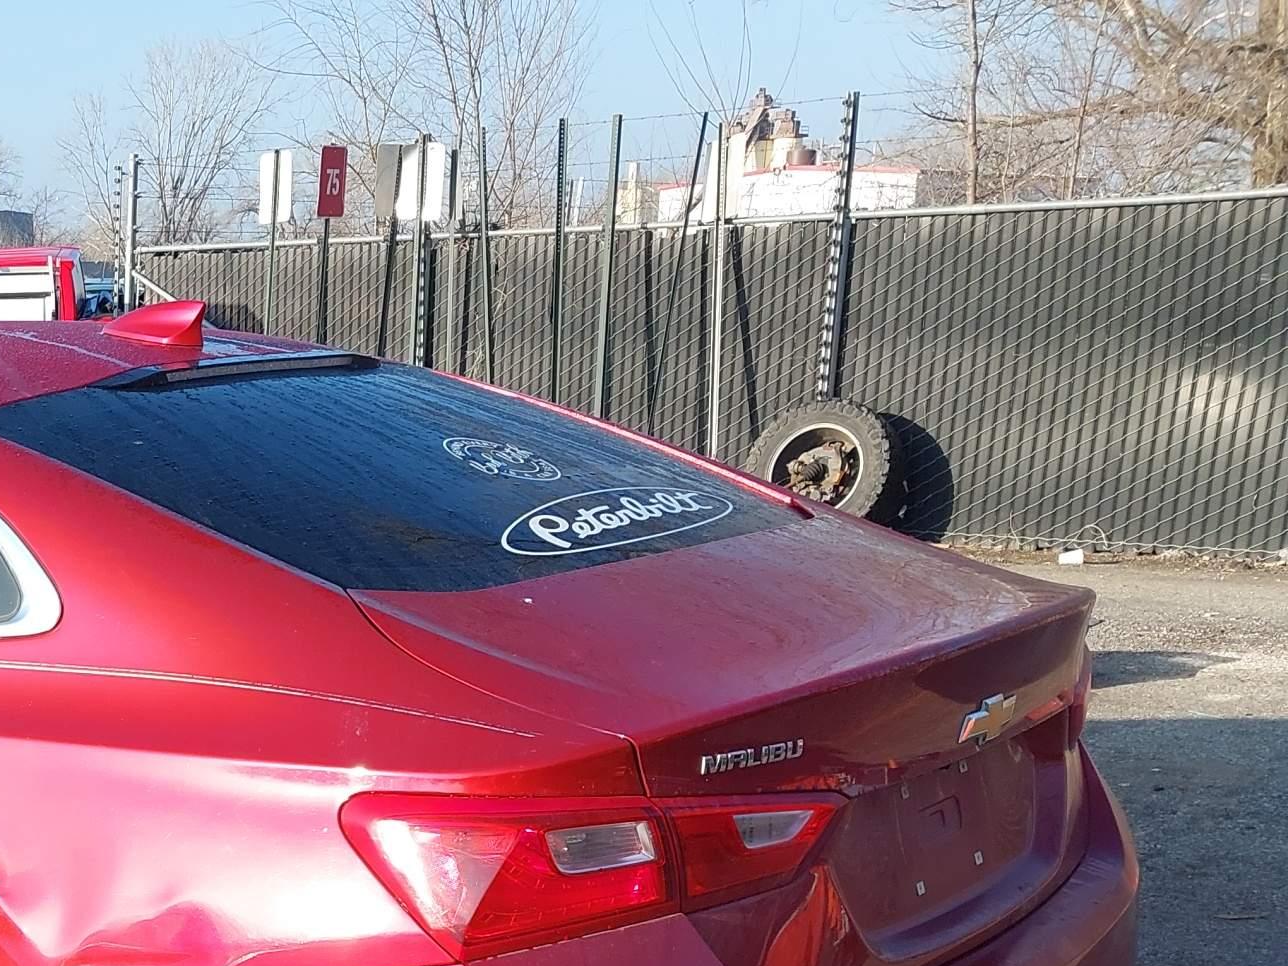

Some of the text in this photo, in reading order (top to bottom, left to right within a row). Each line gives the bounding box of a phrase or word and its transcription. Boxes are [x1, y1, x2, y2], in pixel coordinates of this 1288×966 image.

[326, 168, 340, 196] 75
[528, 492, 713, 549] Peterbilt
[700, 738, 805, 776] MALIBU
